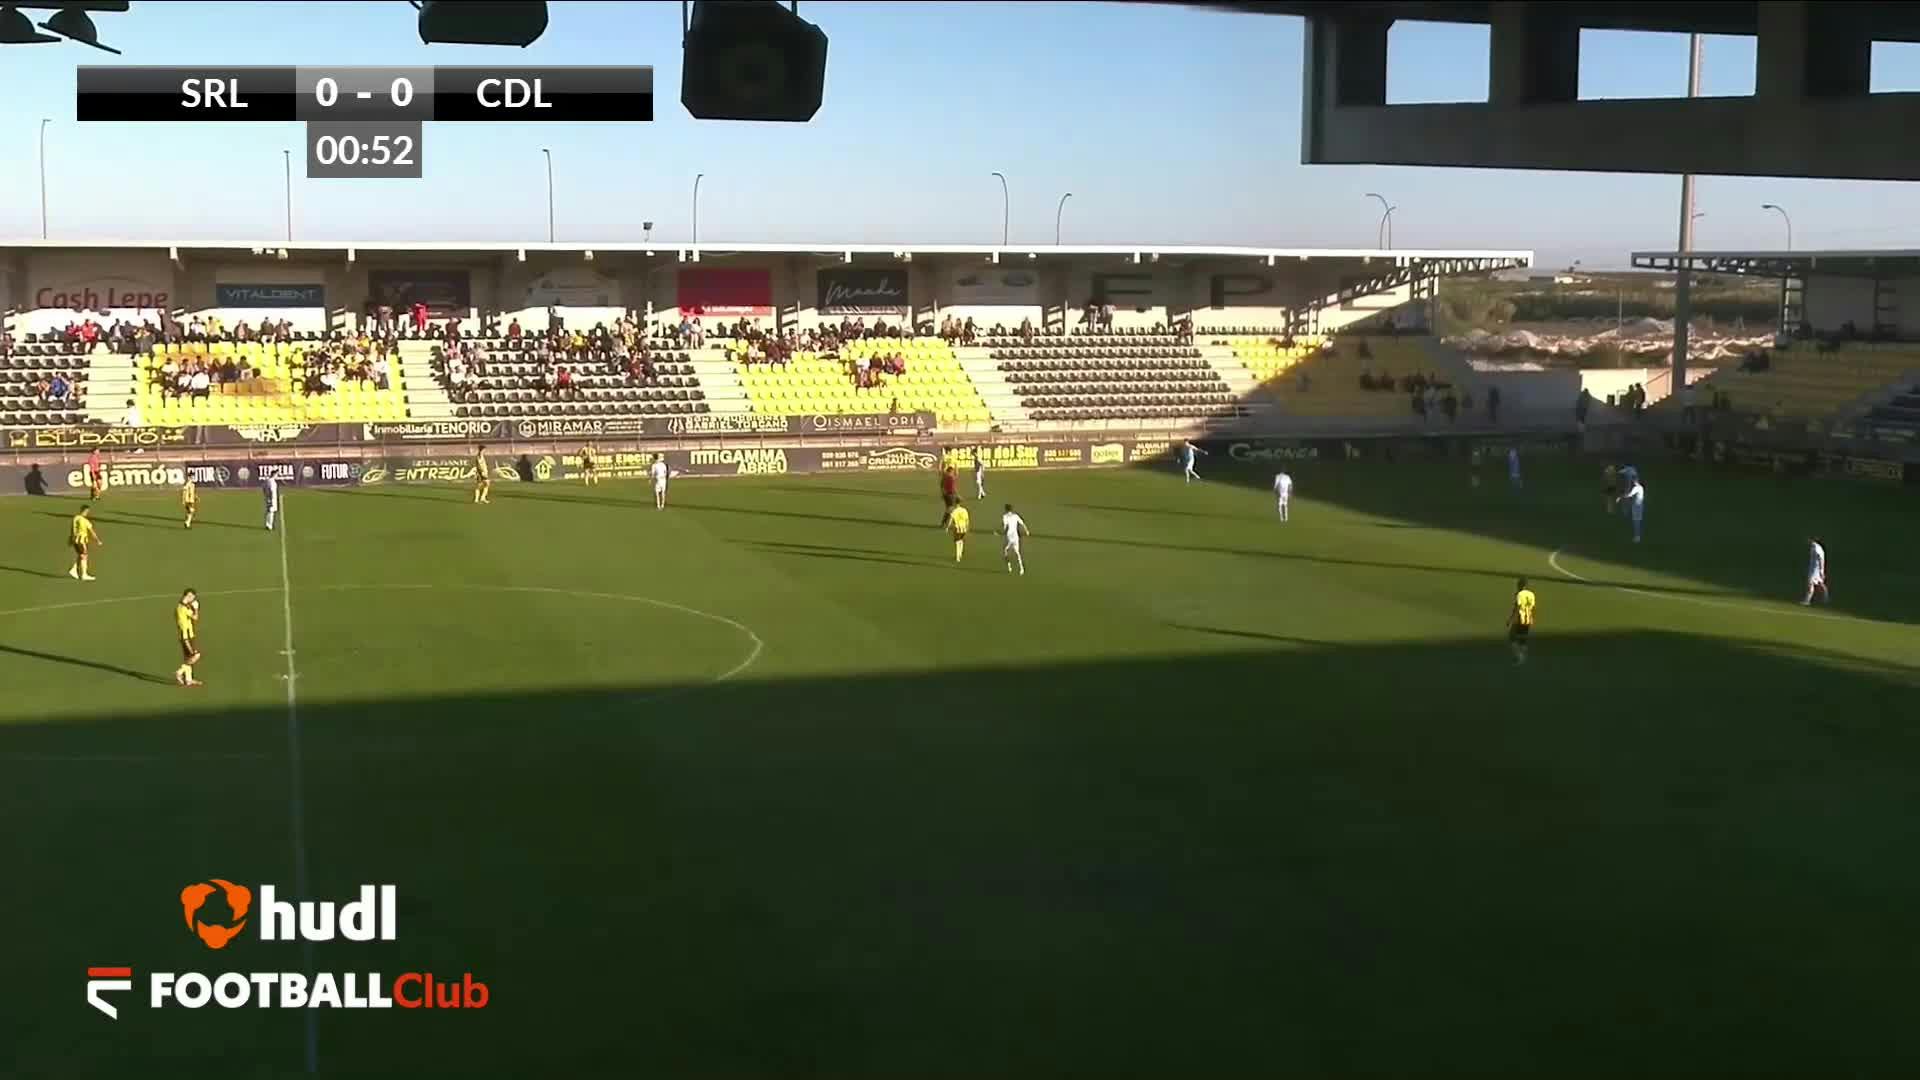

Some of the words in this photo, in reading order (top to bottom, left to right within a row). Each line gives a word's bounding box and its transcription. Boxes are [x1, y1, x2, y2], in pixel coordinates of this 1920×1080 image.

[36, 287, 104, 312] Cash
[108, 287, 169, 314] Lepe
[224, 288, 315, 301] VITALDENT
[538, 421, 602, 431] MIRAMAR
[889, 416, 925, 425] ORIA
[433, 422, 491, 434] TENORIO
[80, 431, 158, 446] PATIO
[720, 449, 786, 463] GAMMA
[321, 464, 349, 480] FUTUR
[737, 461, 787, 474] ABREU
